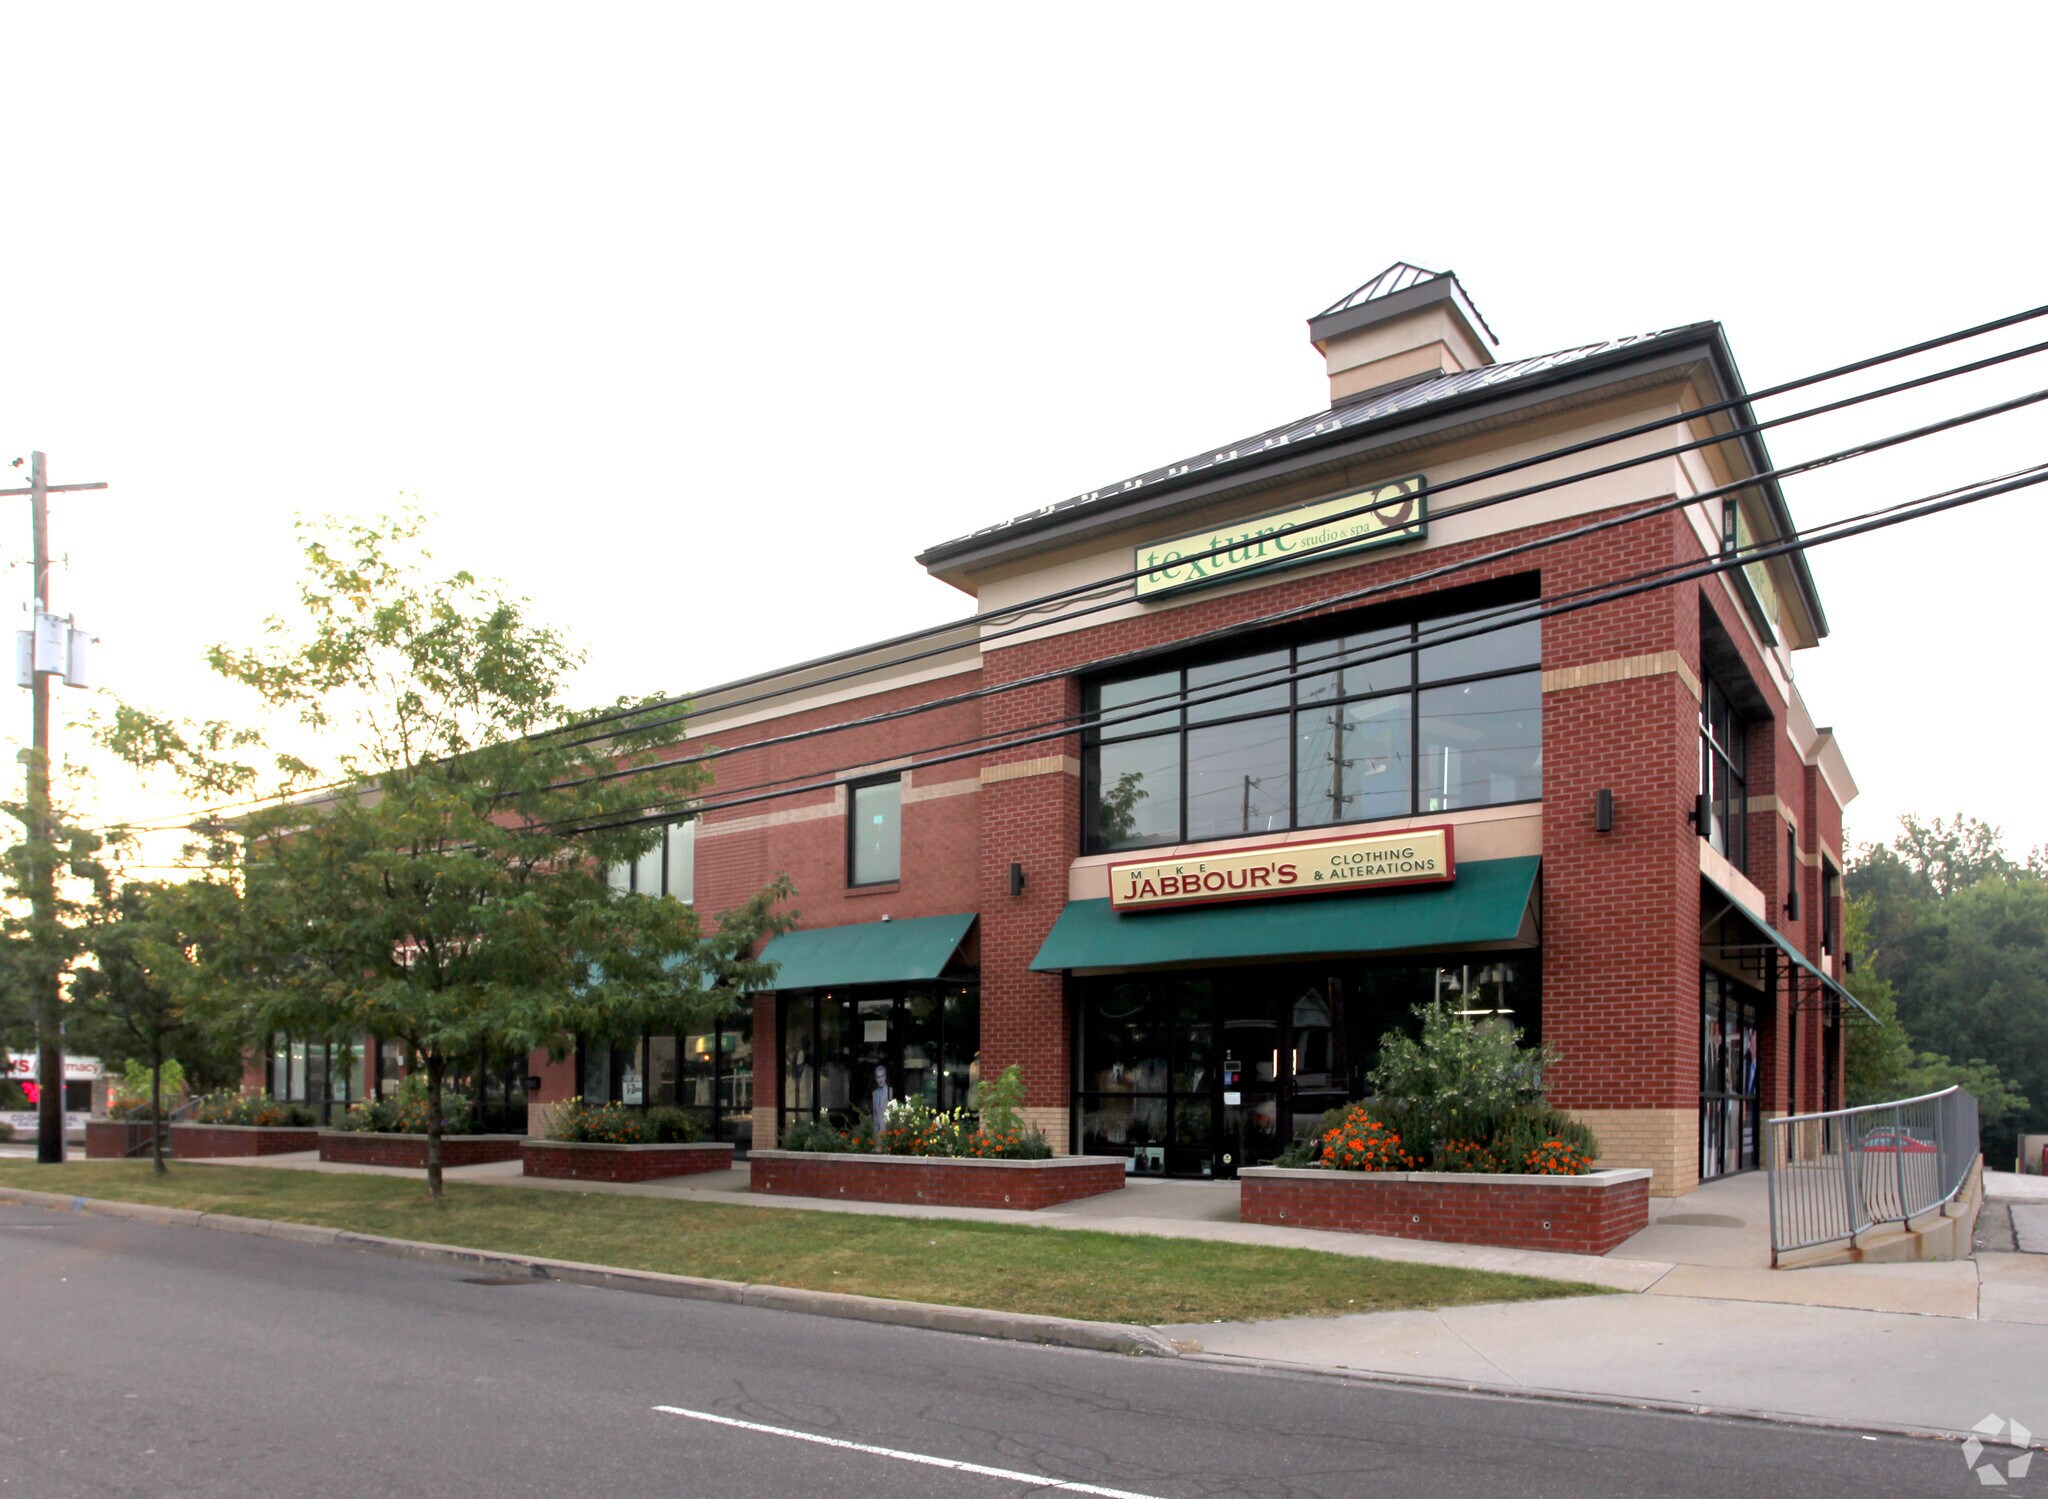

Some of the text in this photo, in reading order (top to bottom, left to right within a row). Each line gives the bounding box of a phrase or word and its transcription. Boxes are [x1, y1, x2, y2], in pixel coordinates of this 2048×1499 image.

[1300, 522, 1371, 548] studio & spa
[1146, 522, 1298, 584] texture
[1330, 847, 1415, 867] CLOTHING
[1123, 862, 1299, 900] JABBOUR'S
[1130, 863, 1207, 880] MIKE
[1313, 858, 1436, 882] & ALTERATIONS
